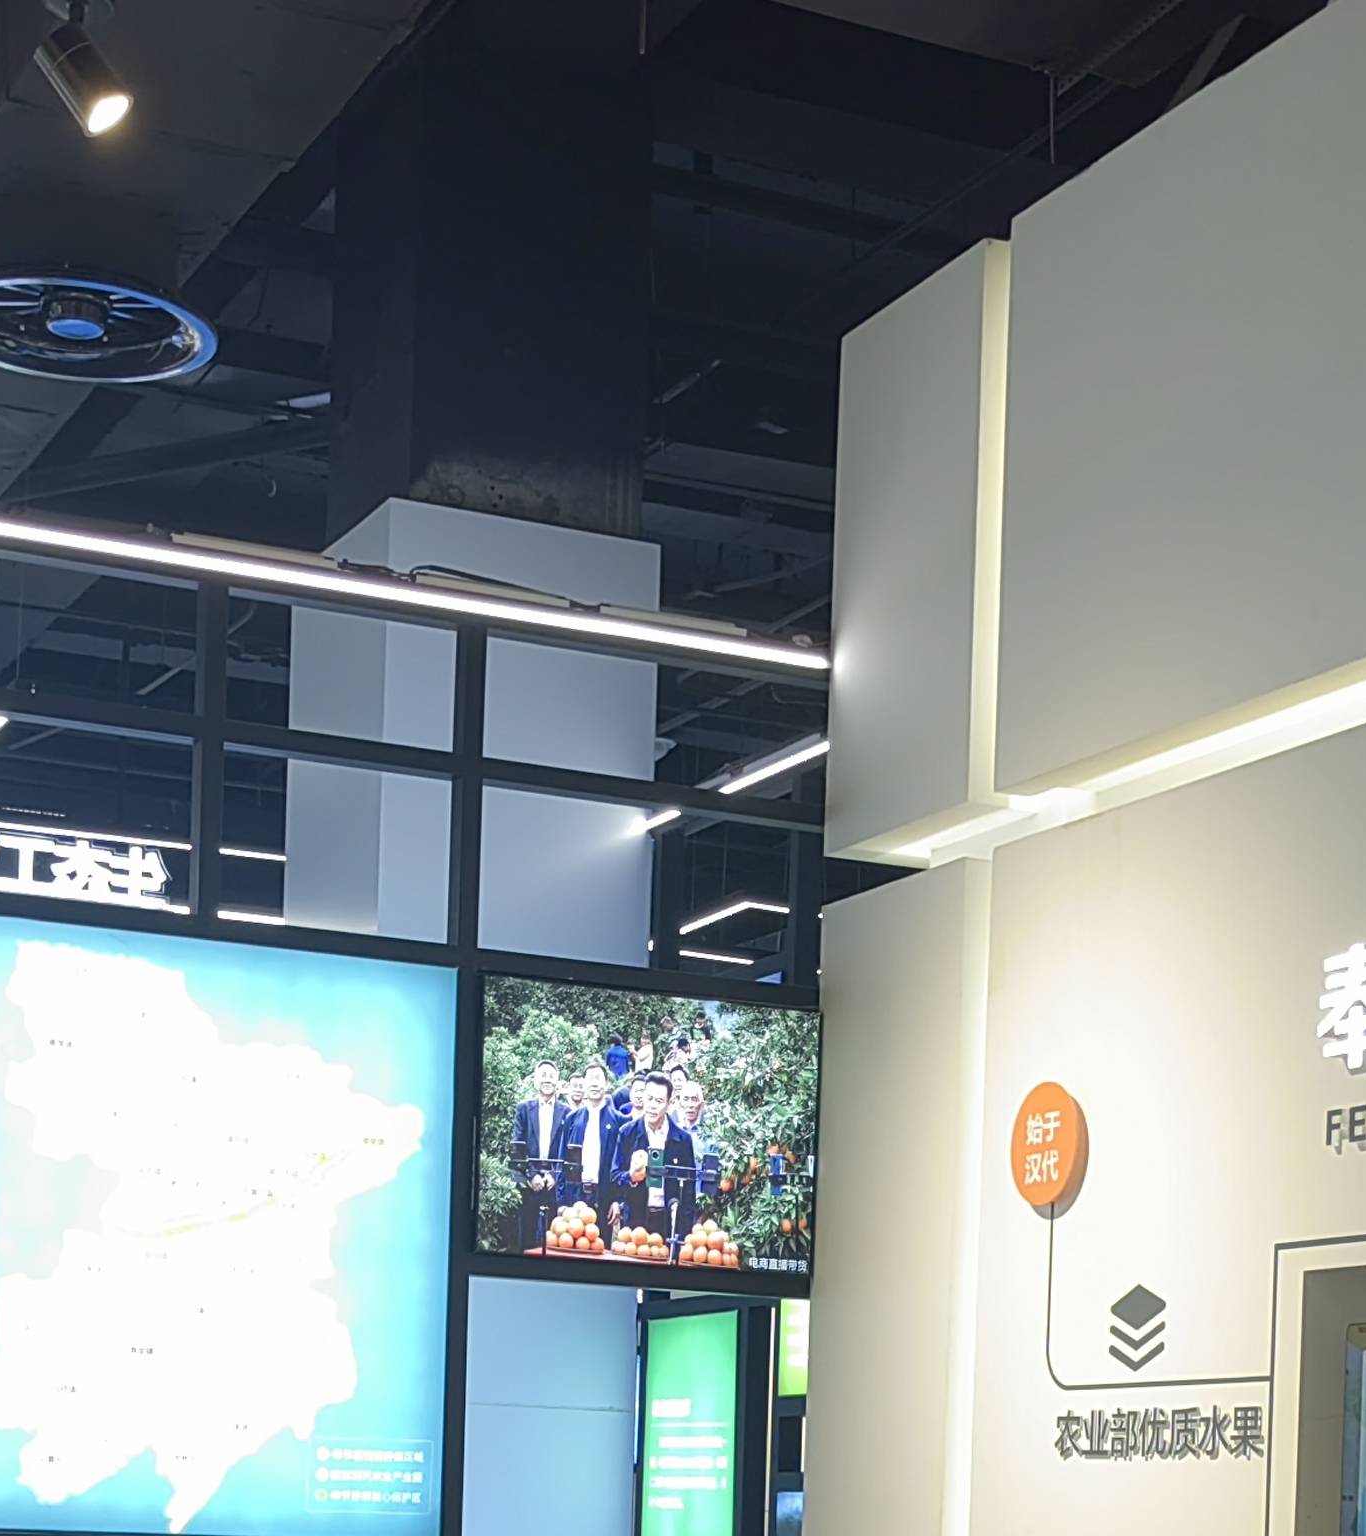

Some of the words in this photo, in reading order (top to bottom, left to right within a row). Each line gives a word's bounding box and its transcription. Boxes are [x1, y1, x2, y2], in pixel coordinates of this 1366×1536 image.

[1025, 1110, 1061, 1145] 始于
[1024, 1150, 1059, 1184] 汉代
[748, 1256, 809, 1273] 电商直播带货
[1054, 1404, 1265, 1460] 农业部优质水果
